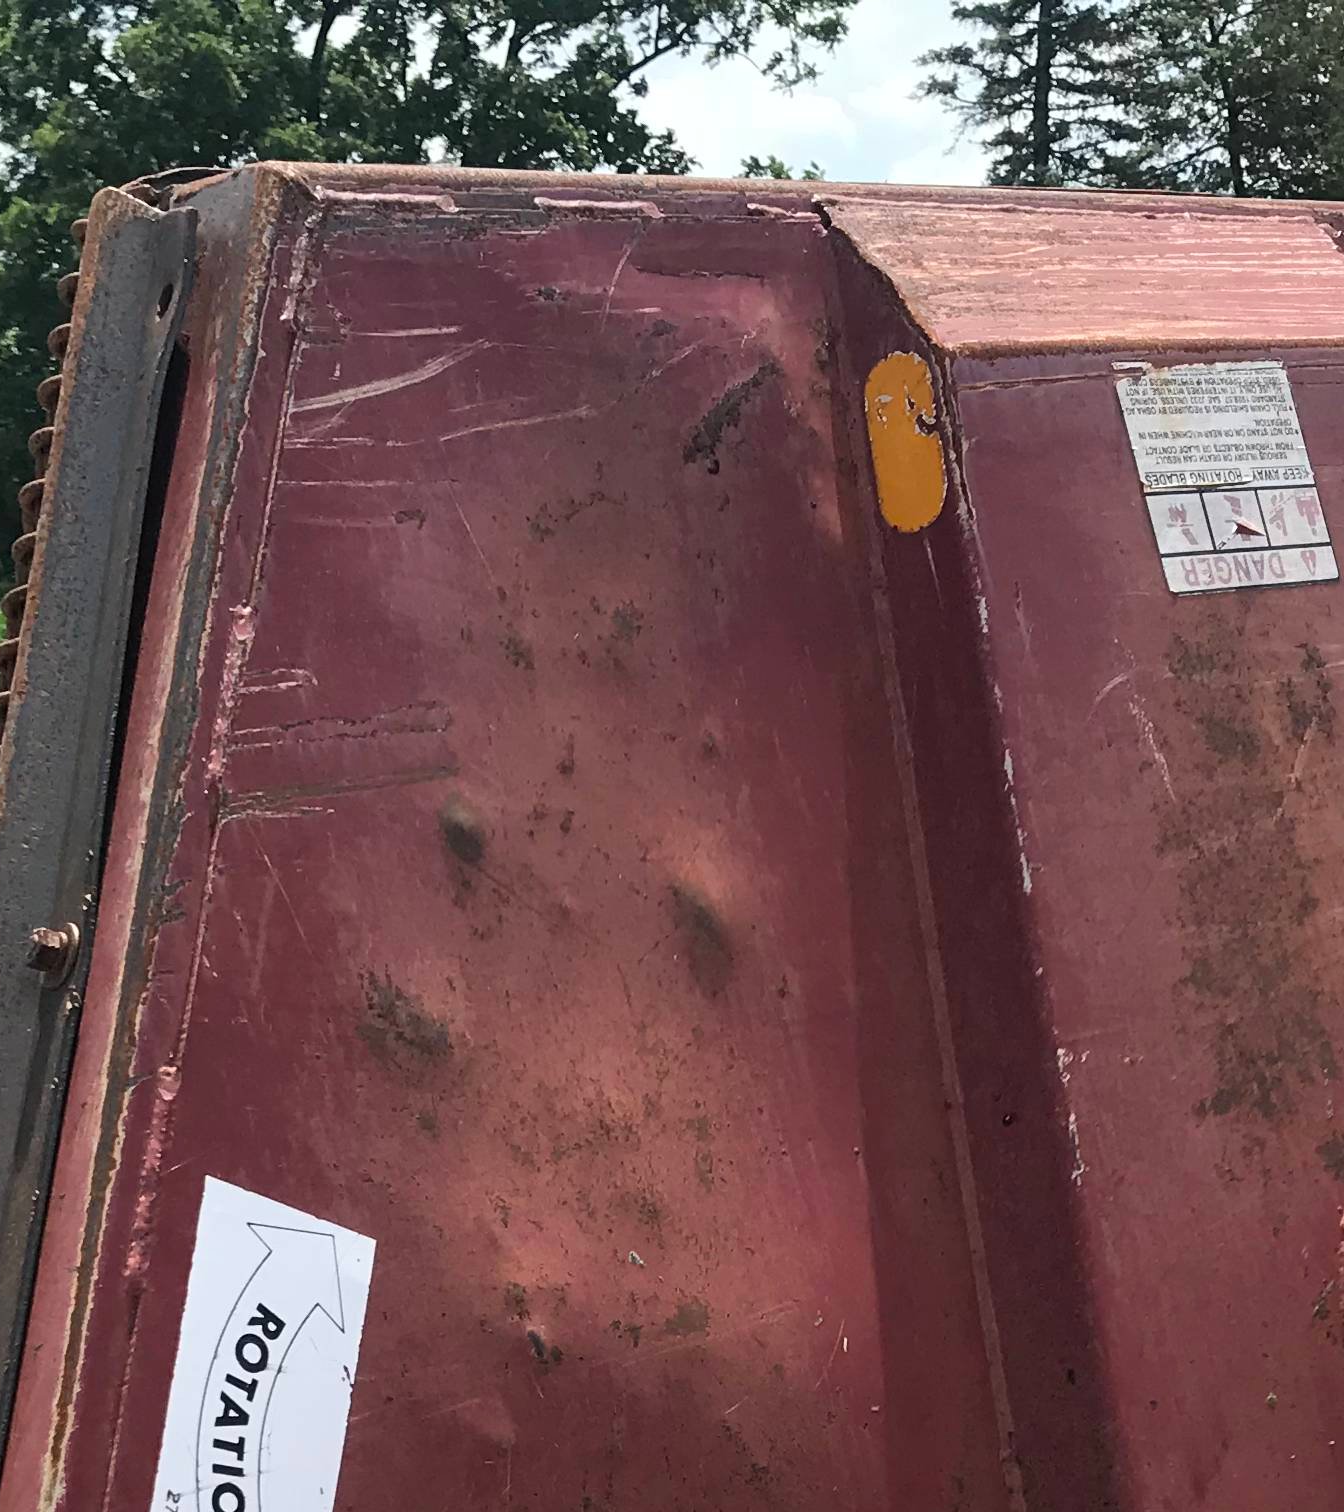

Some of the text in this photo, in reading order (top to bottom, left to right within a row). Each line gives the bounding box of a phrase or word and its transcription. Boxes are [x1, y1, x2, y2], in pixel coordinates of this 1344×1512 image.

[1144, 472, 1187, 486] BLADES
[1189, 469, 1243, 484] ROTATING
[1251, 468, 1280, 481] AWAY
[1181, 553, 1285, 586] DANGER
